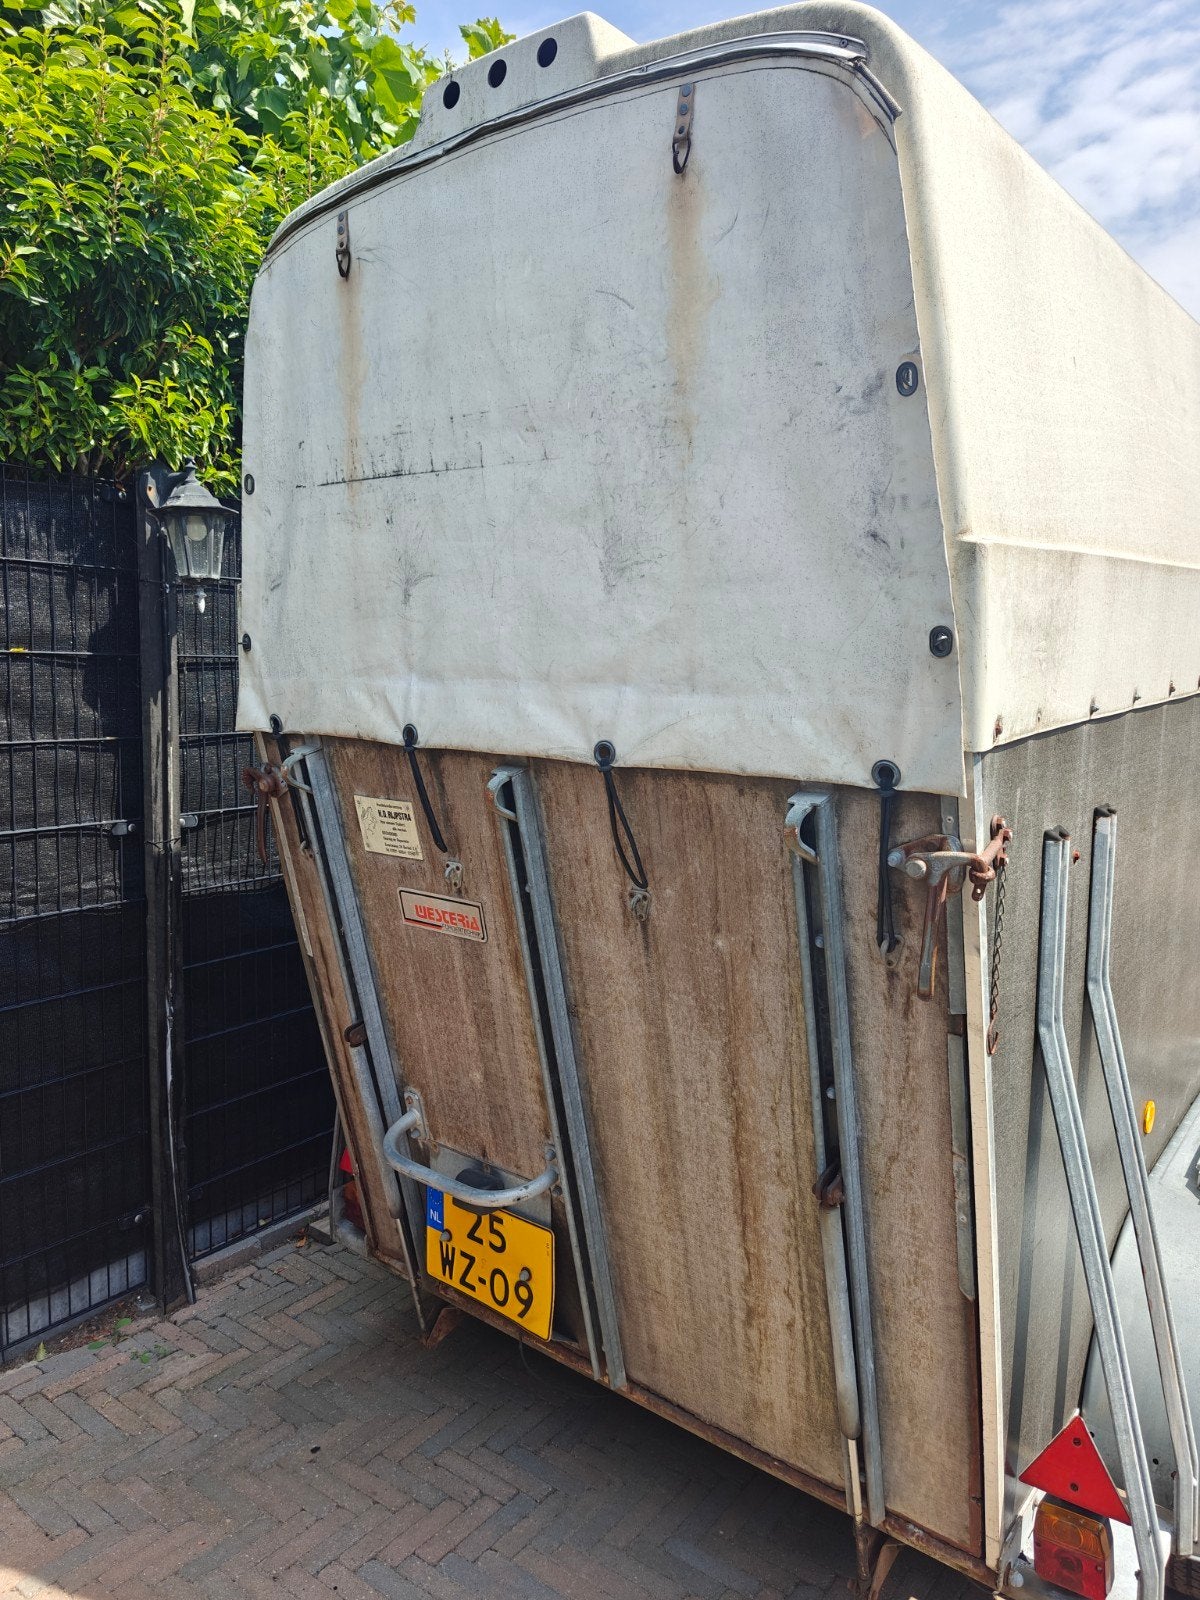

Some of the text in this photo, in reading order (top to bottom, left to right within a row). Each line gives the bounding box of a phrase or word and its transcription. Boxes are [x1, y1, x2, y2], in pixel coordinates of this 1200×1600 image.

[430, 1208, 442, 1224] NL
[466, 1213, 507, 1254] 25
[439, 1240, 534, 1319] WZ-09
